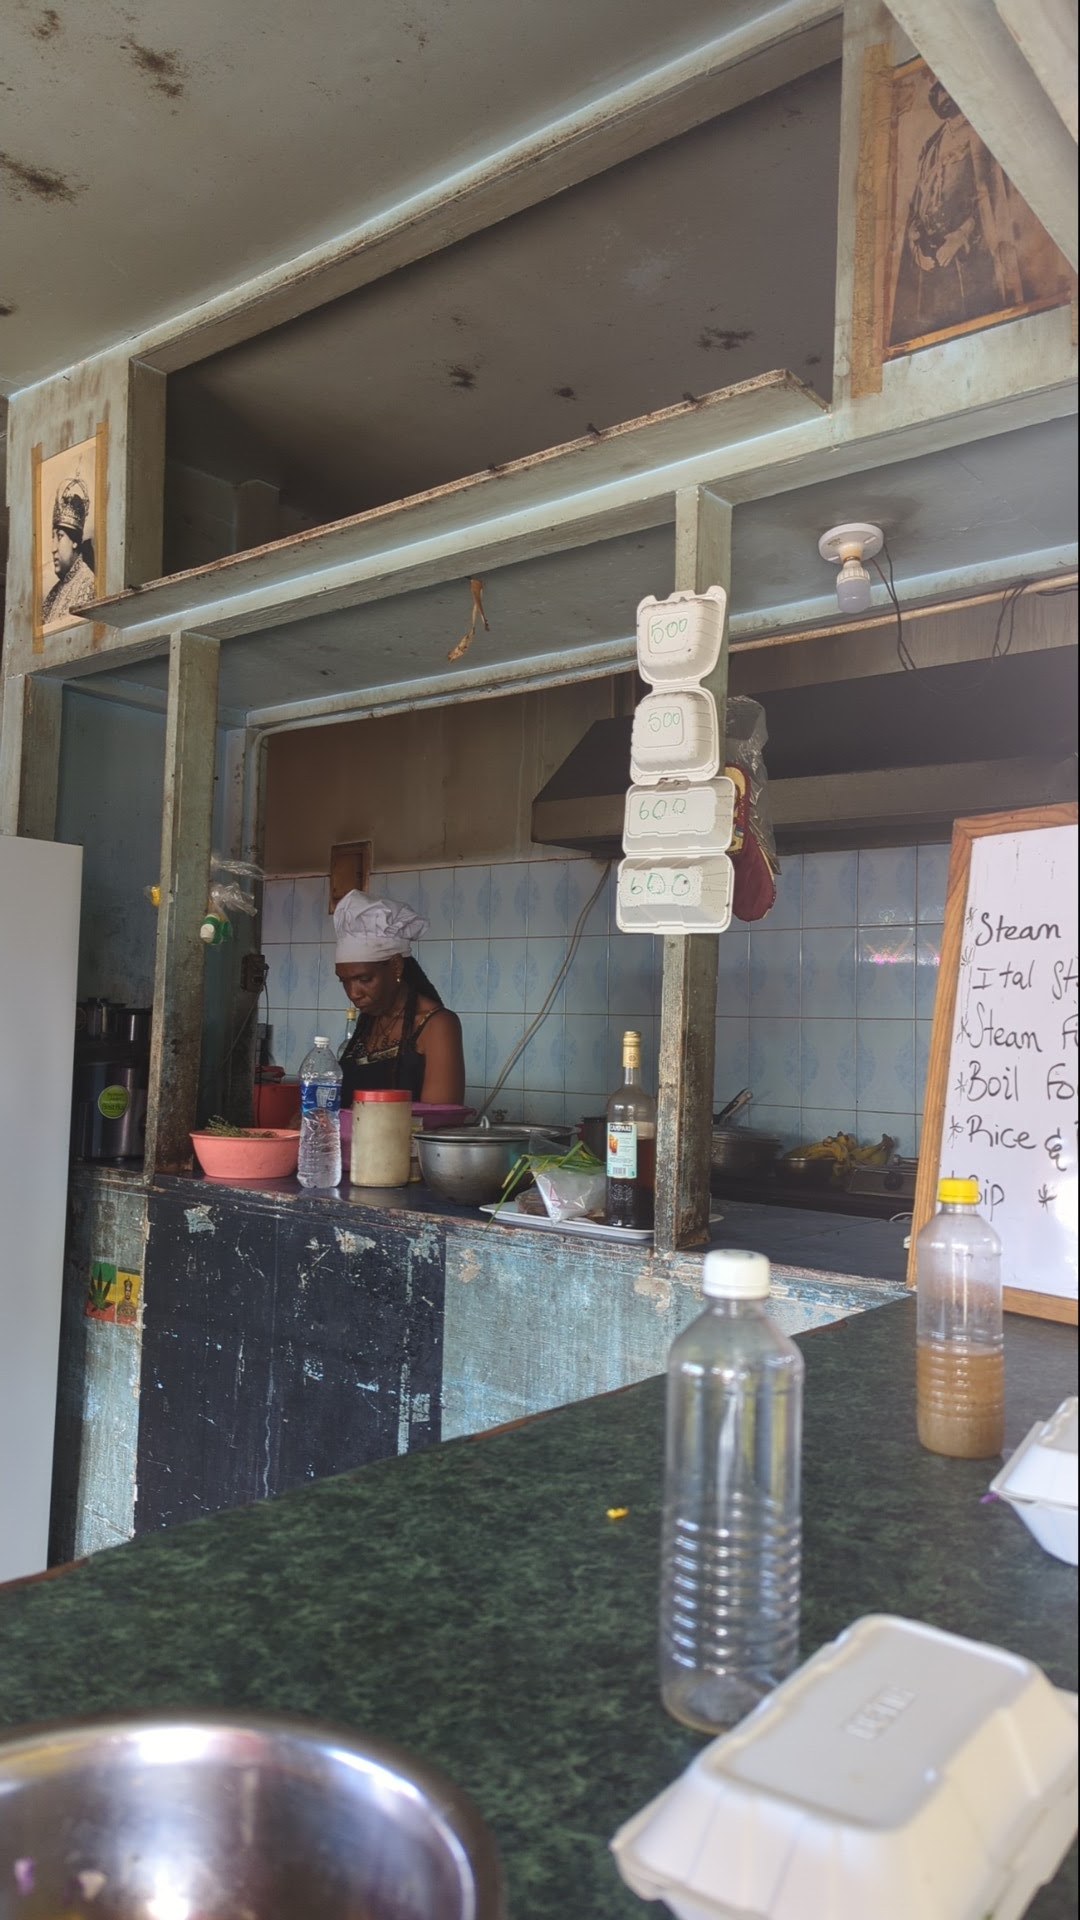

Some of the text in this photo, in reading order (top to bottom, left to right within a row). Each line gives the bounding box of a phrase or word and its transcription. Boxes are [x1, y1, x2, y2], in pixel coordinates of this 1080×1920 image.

[651, 618, 688, 644] 500
[648, 712, 681, 732] 500
[638, 798, 687, 820] 600
[630, 872, 691, 896] 600
[975, 912, 1062, 946] Steam
[969, 1001, 1043, 1053] Steam
[967, 1060, 1019, 1101] Boil
[967, 1115, 1037, 1149] Rice
